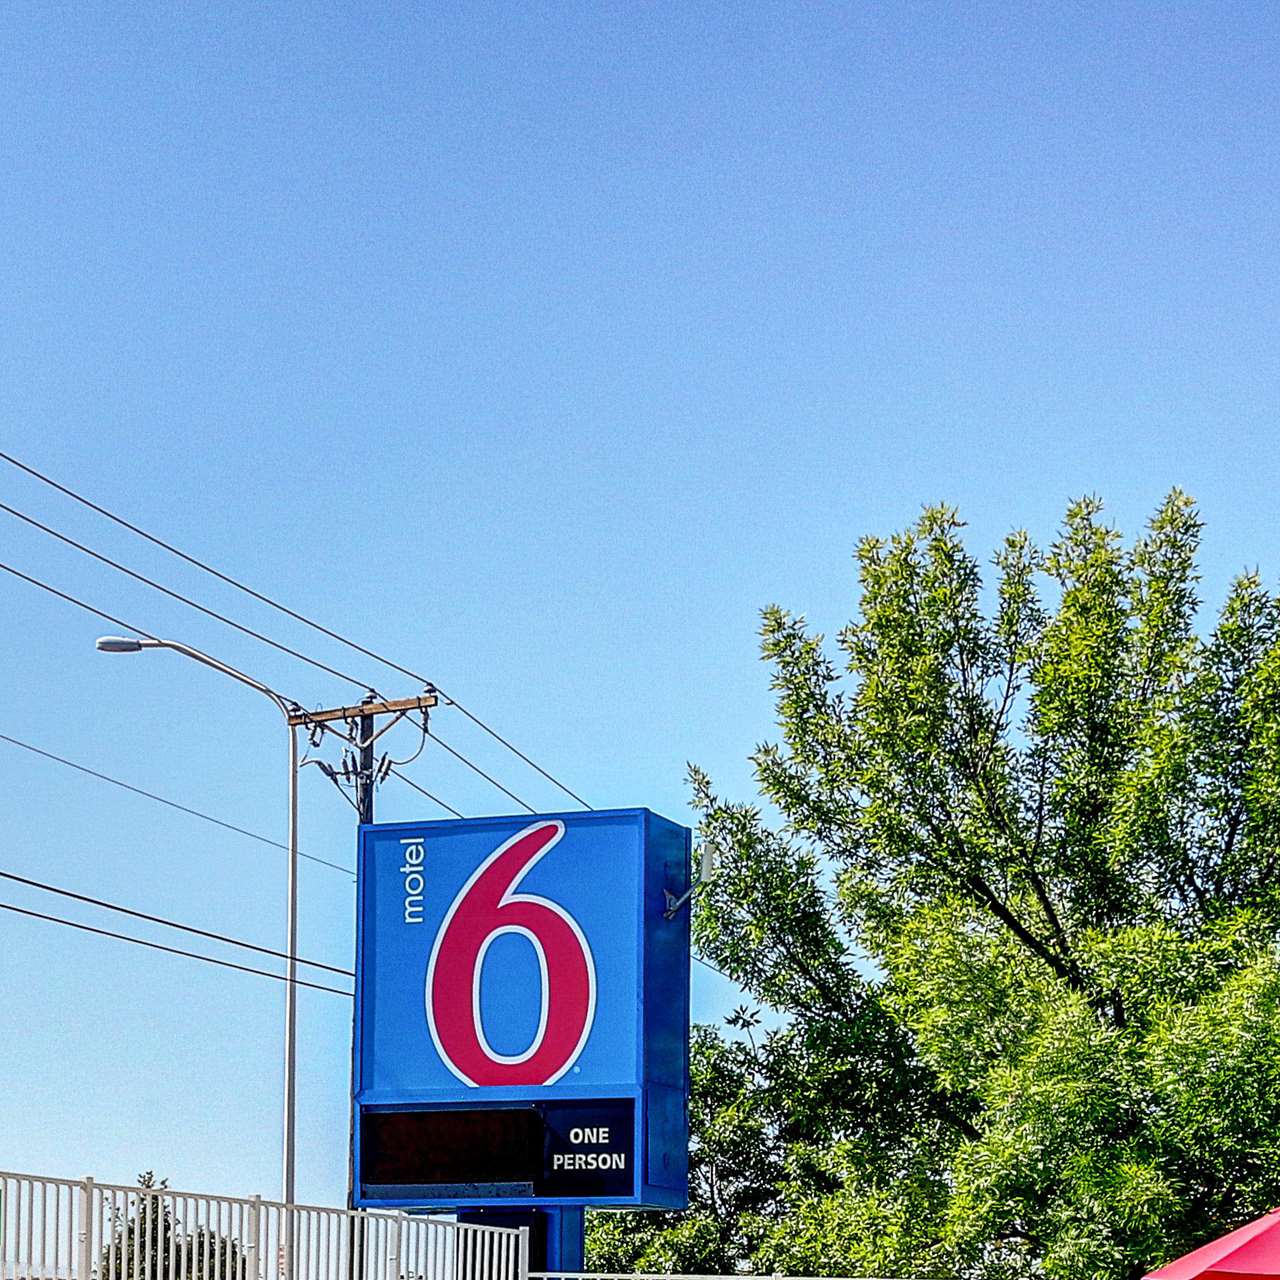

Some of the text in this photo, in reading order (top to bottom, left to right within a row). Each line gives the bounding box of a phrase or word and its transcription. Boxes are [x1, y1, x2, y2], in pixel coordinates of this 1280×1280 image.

[400, 838, 425, 923] motel
[426, 819, 598, 1088] 6
[569, 1127, 610, 1144] ONE
[553, 1153, 626, 1170] PERSON
